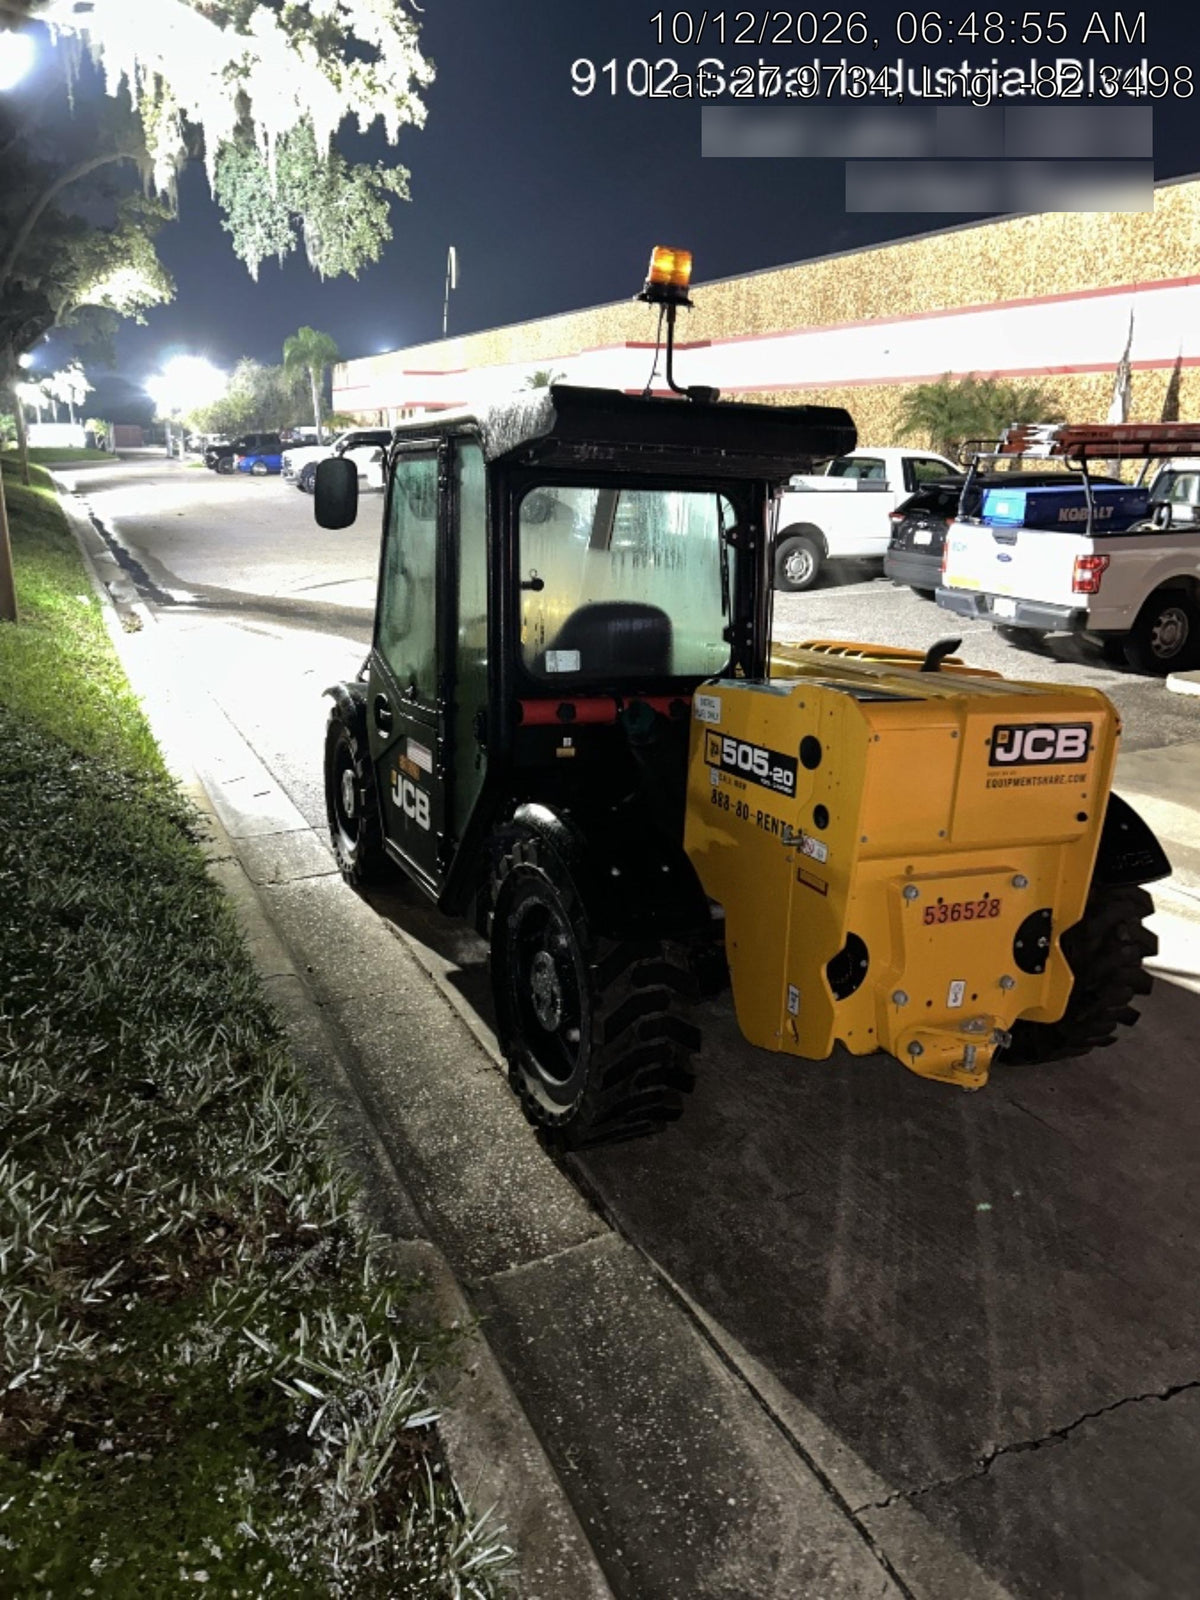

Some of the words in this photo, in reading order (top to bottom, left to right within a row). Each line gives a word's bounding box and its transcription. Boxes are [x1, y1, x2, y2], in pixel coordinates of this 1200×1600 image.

[995, 728, 1087, 762] JCB
[986, 774, 1087, 789] EQUIPMENTSHARE.COM
[392, 774, 431, 832] JCB
[923, 899, 1001, 925] 536528
